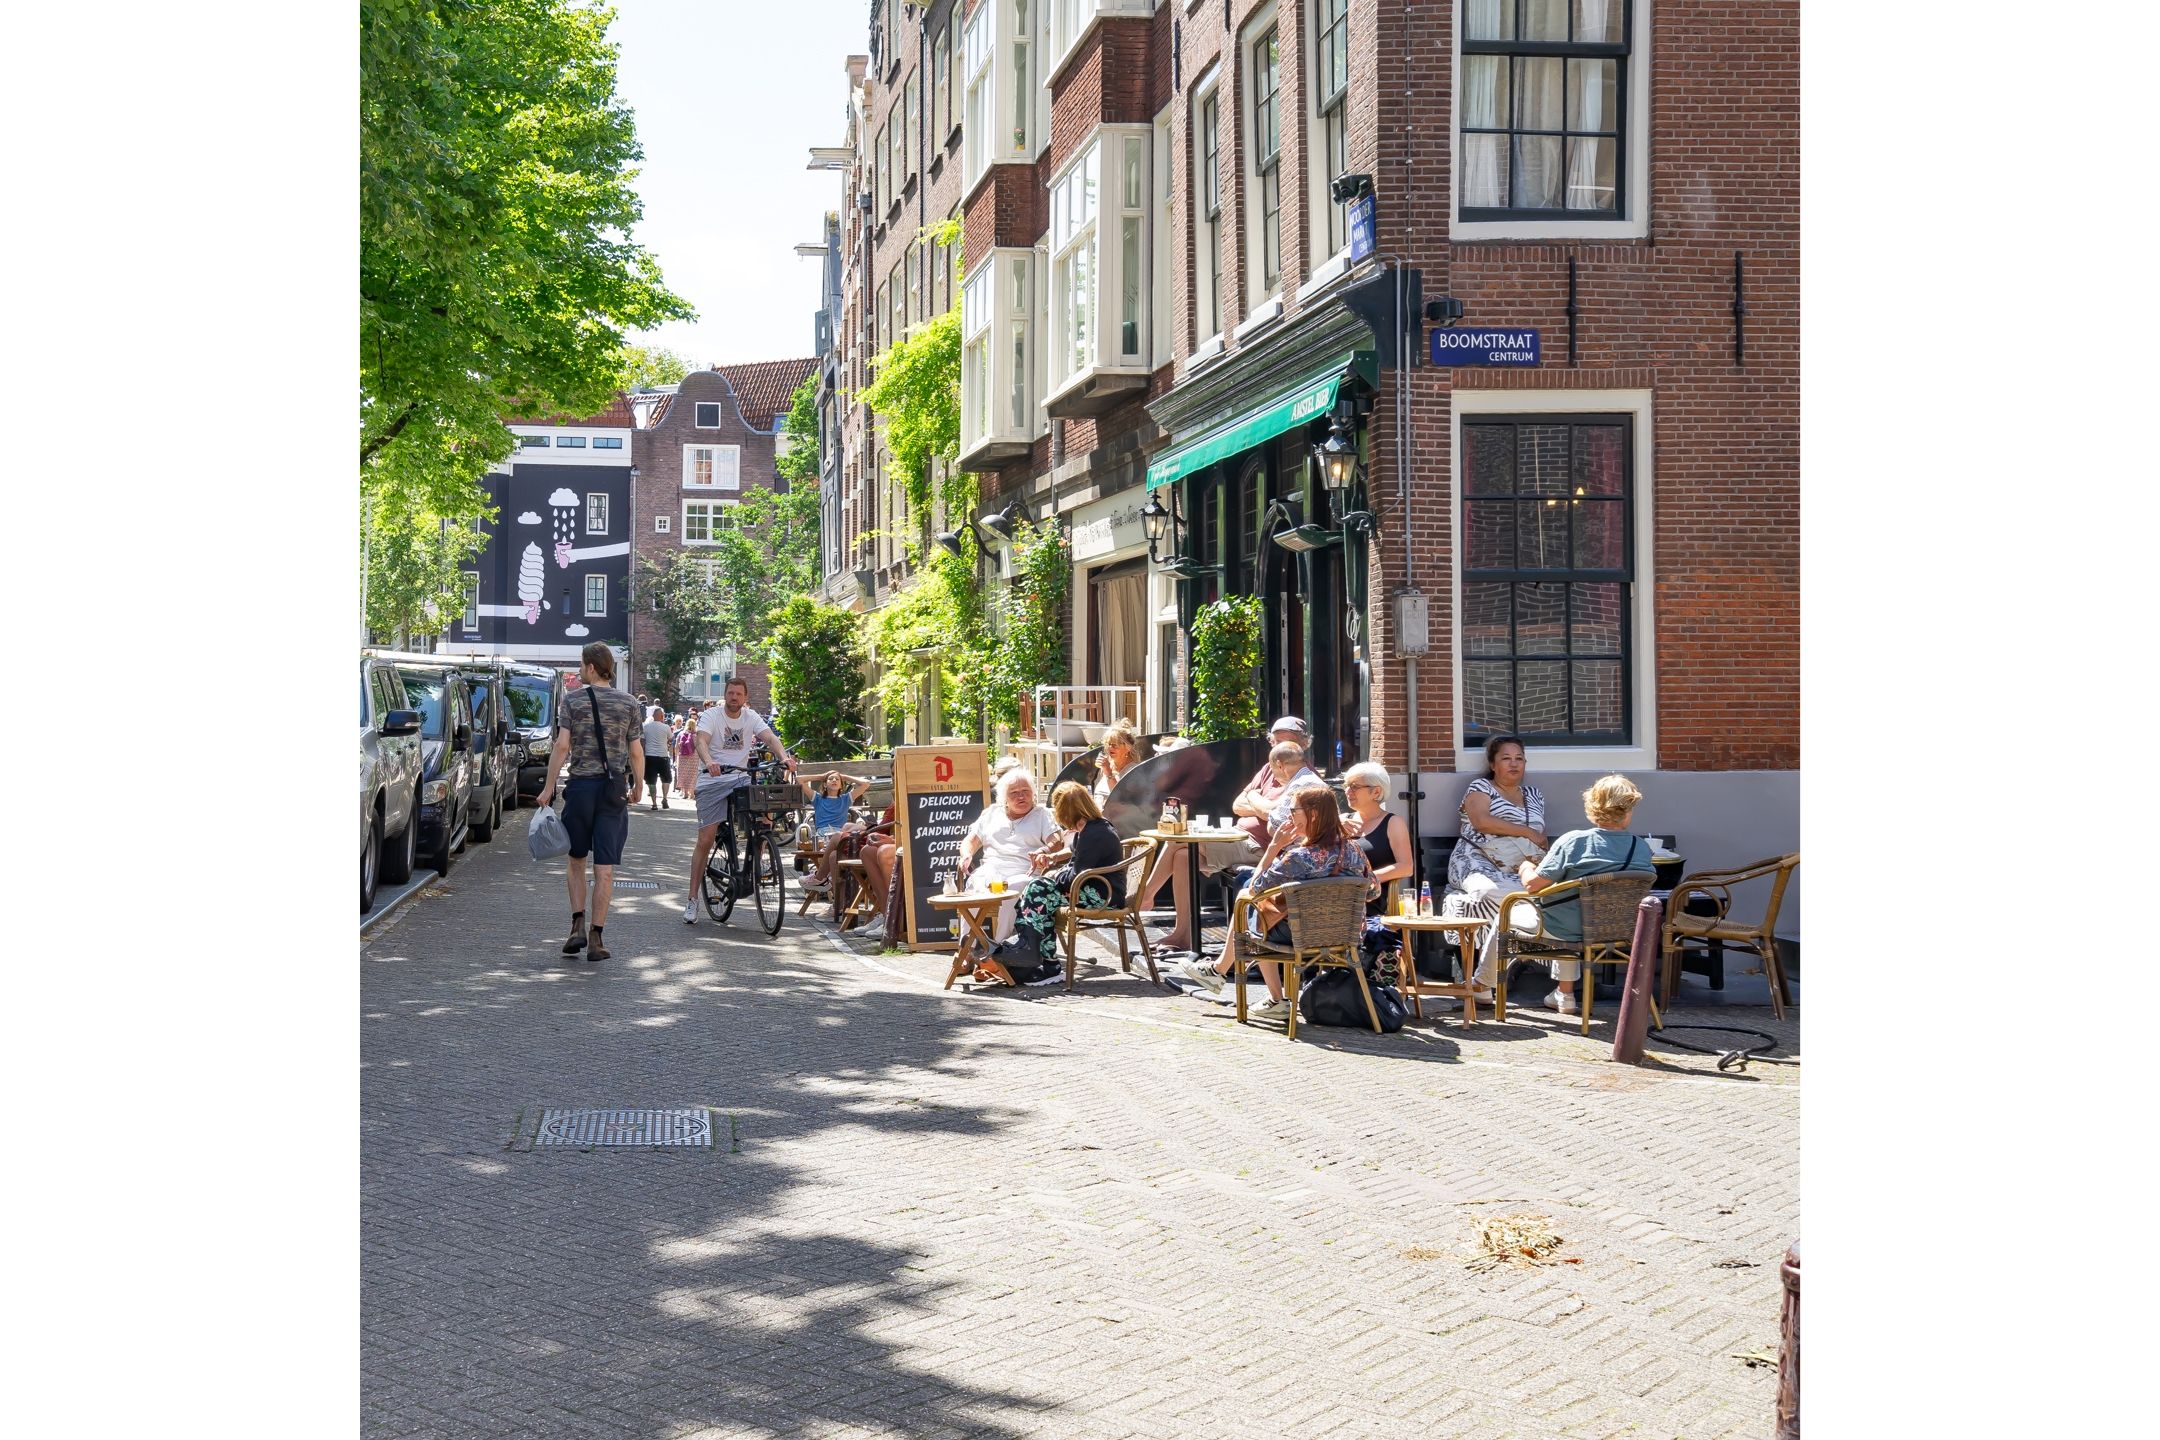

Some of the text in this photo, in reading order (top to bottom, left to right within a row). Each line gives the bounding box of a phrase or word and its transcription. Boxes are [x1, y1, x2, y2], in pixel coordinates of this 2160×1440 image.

[1440, 333, 1532, 348] BOOMSTRAAT
[1489, 352, 1533, 361] CENTRUM
[1291, 394, 1315, 421] AMSTEL
[919, 794, 971, 808] DELICIOUS
[929, 810, 963, 823] LUNCH
[915, 825, 972, 839] SANDWICH
[928, 840, 962, 853] COFFE
[930, 856, 961, 868] PAST
[933, 871, 967, 883] BEE
